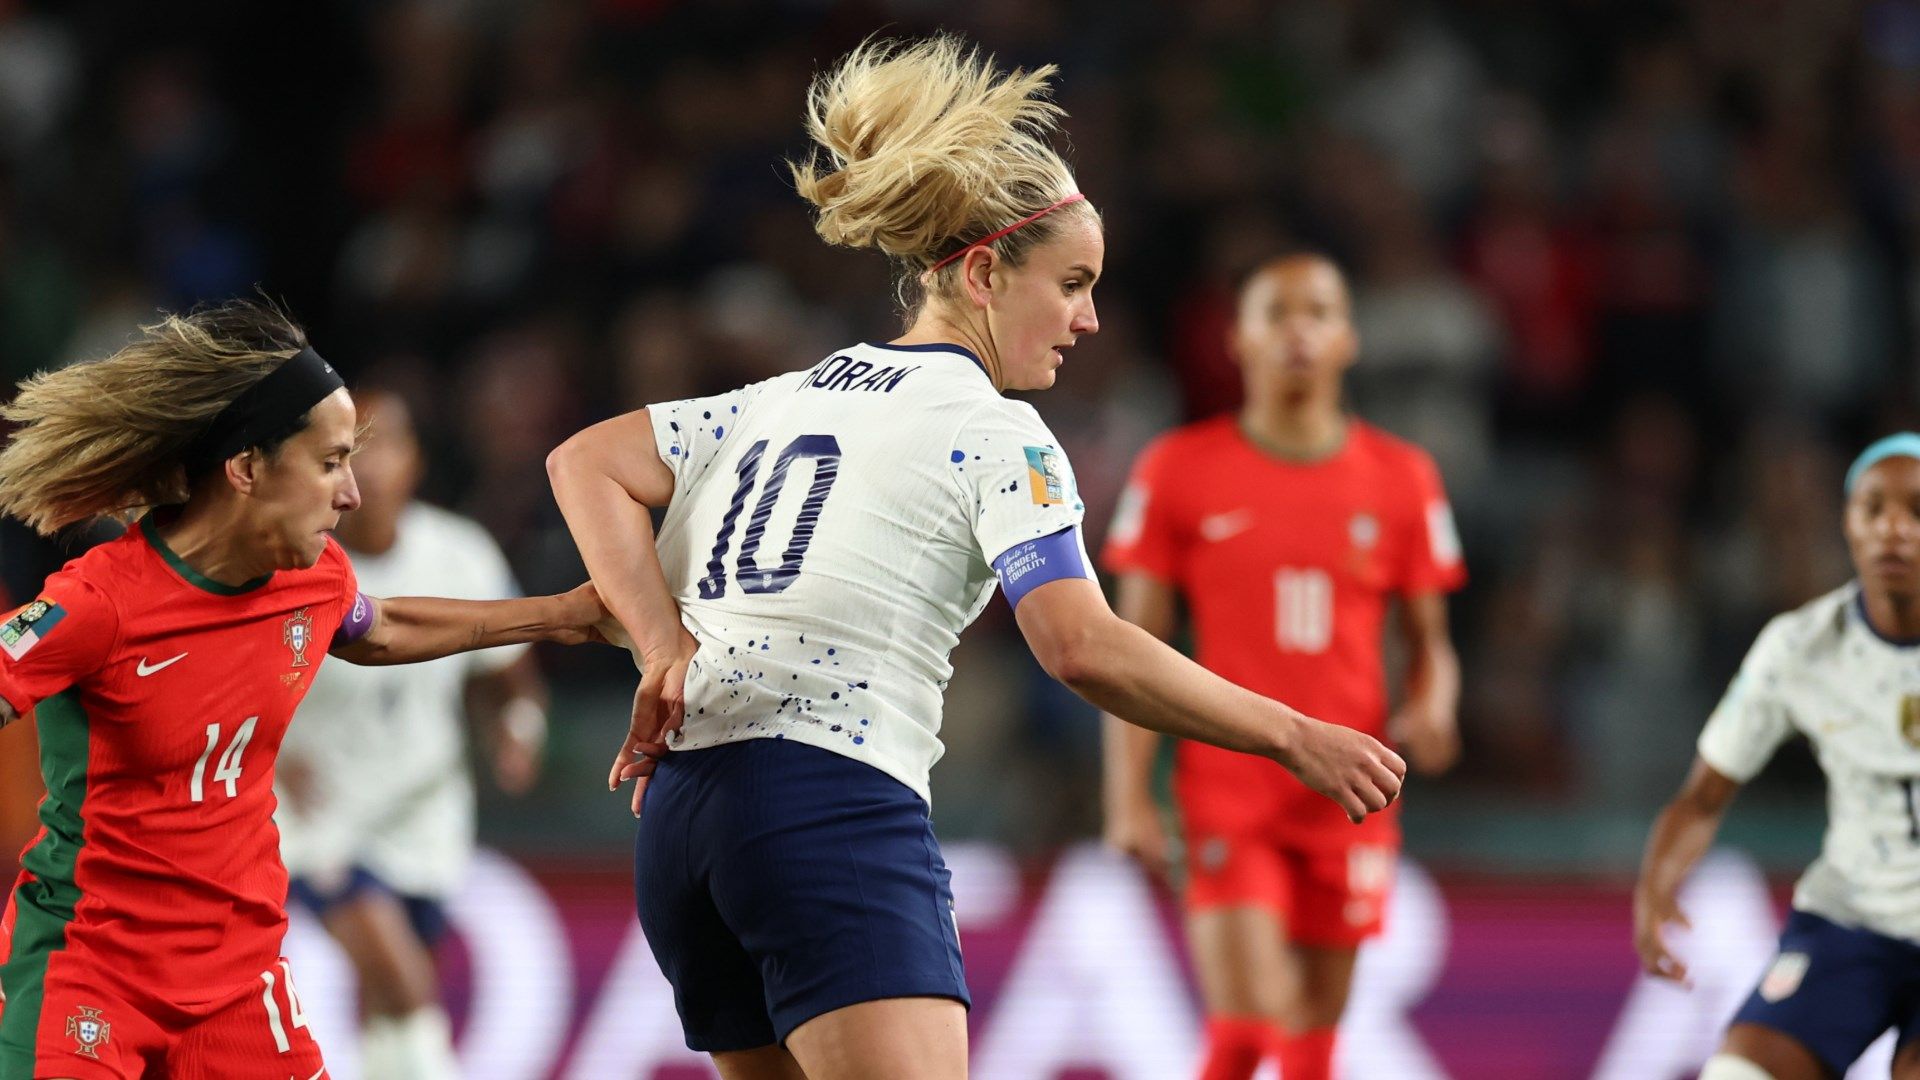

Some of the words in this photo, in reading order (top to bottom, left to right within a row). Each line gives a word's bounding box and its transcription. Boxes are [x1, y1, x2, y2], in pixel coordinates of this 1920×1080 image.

[796, 354, 922, 392] HORAN
[698, 434, 842, 599] 10
[1006, 551, 1037, 576] GENDER
[1009, 557, 1046, 584] EQUALITY
[191, 716, 259, 802] 14
[260, 960, 316, 1053] 14
